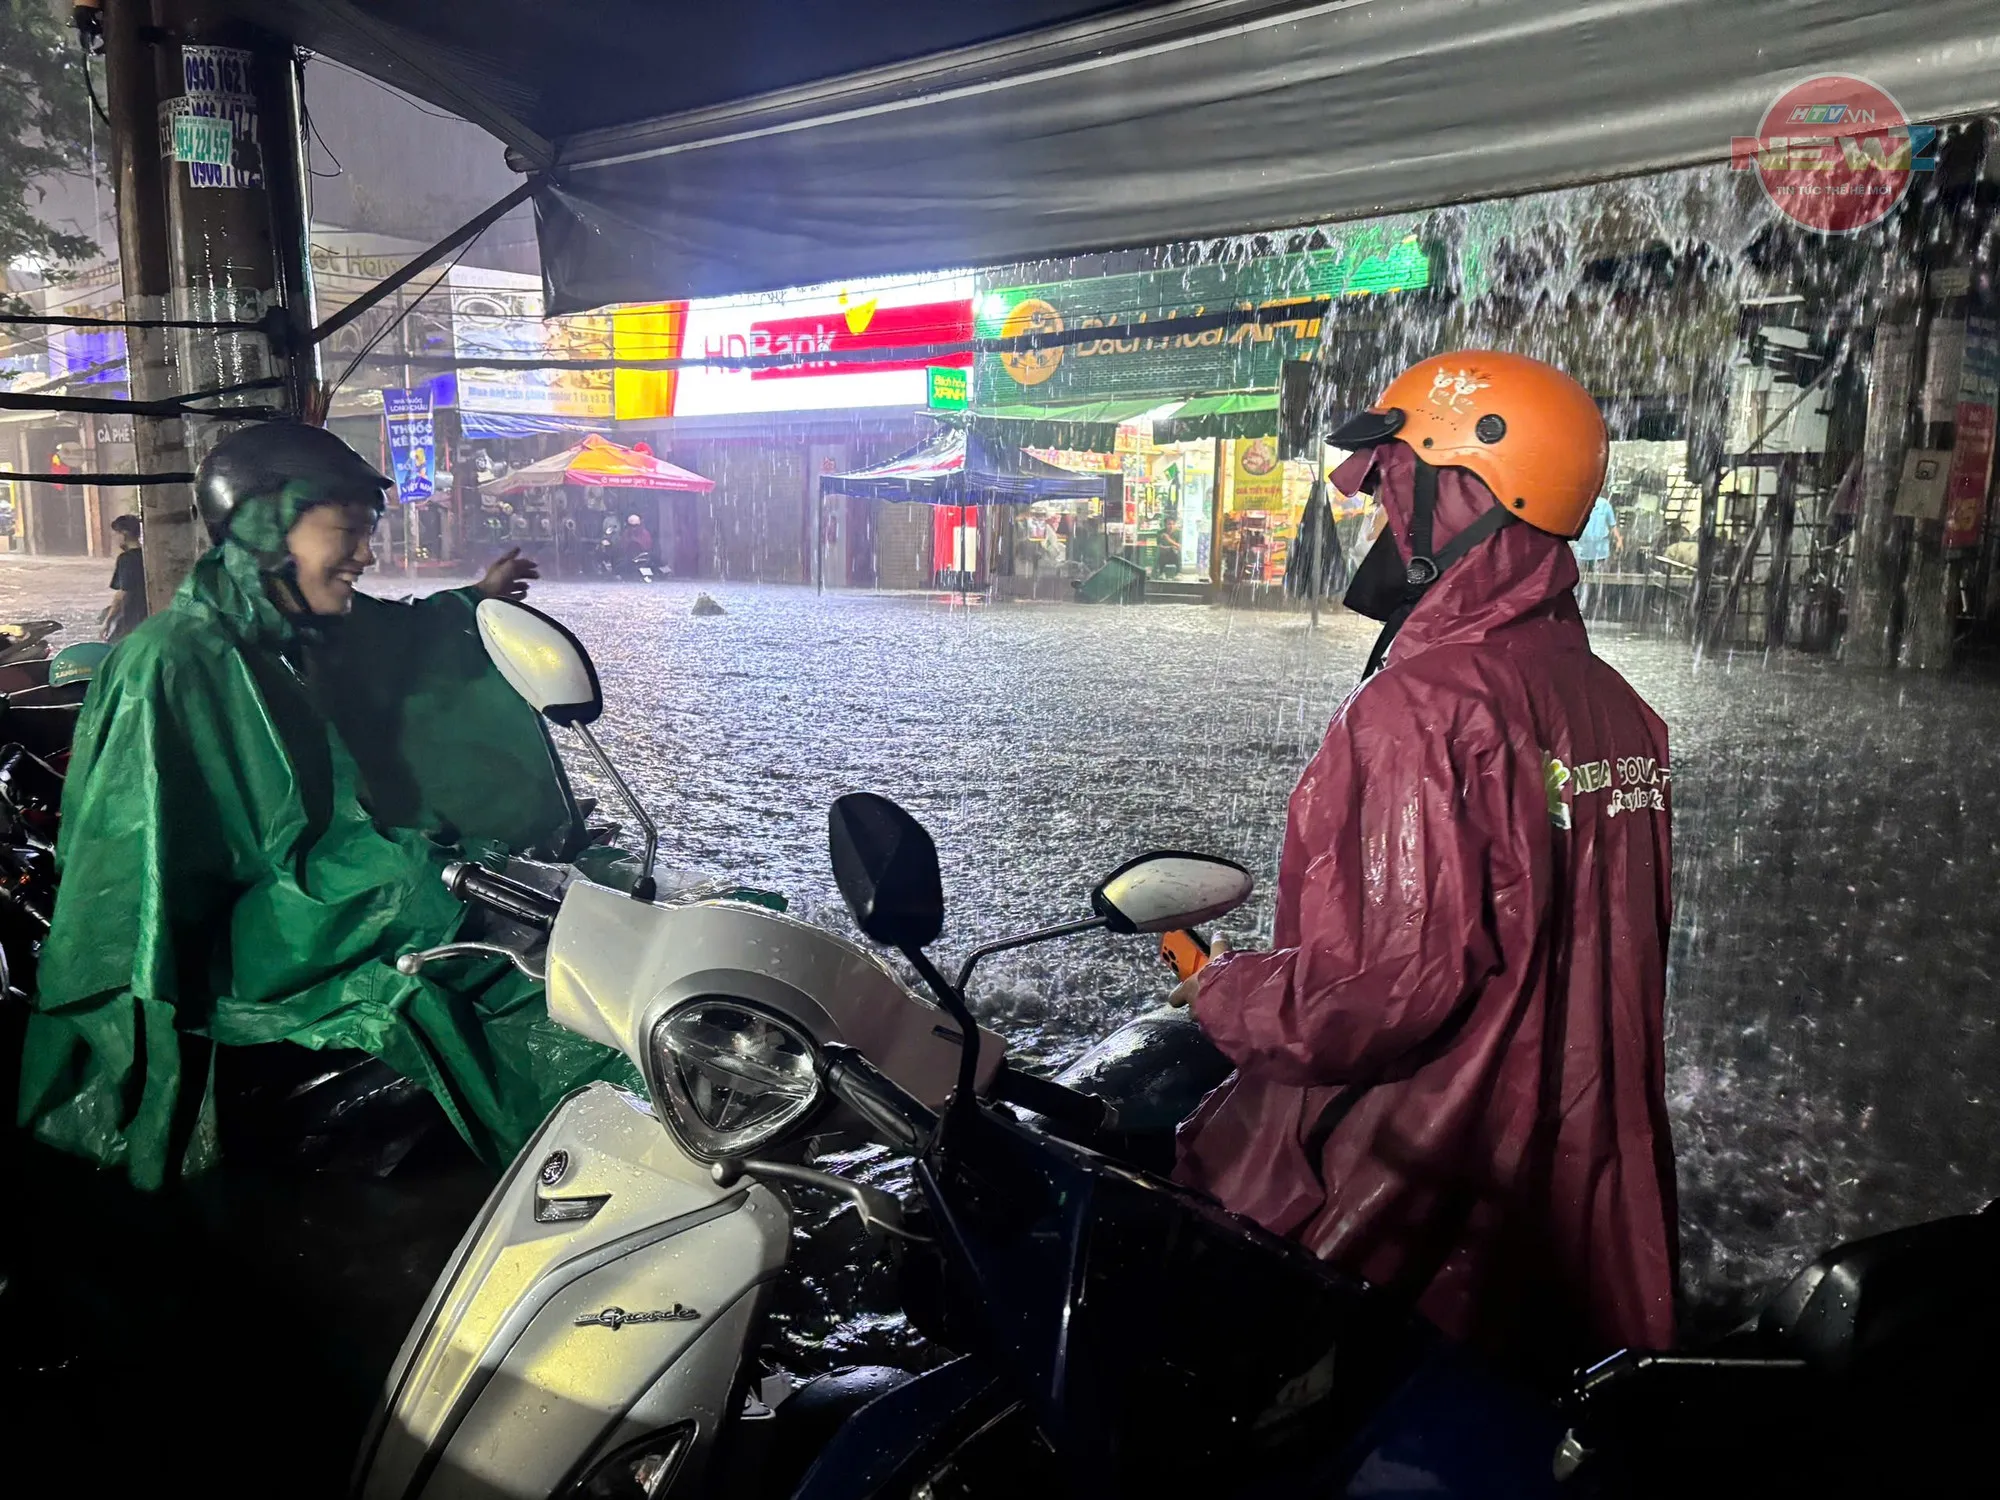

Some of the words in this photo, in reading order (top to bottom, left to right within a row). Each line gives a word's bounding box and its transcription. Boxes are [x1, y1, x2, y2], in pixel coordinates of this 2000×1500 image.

[705, 323, 838, 374] HDBank
[97, 423, 111, 443] CÀ
[391, 420, 433, 435] THUỐC
[392, 435, 409, 447] KÊ
[577, 1303, 701, 1331] Grande
